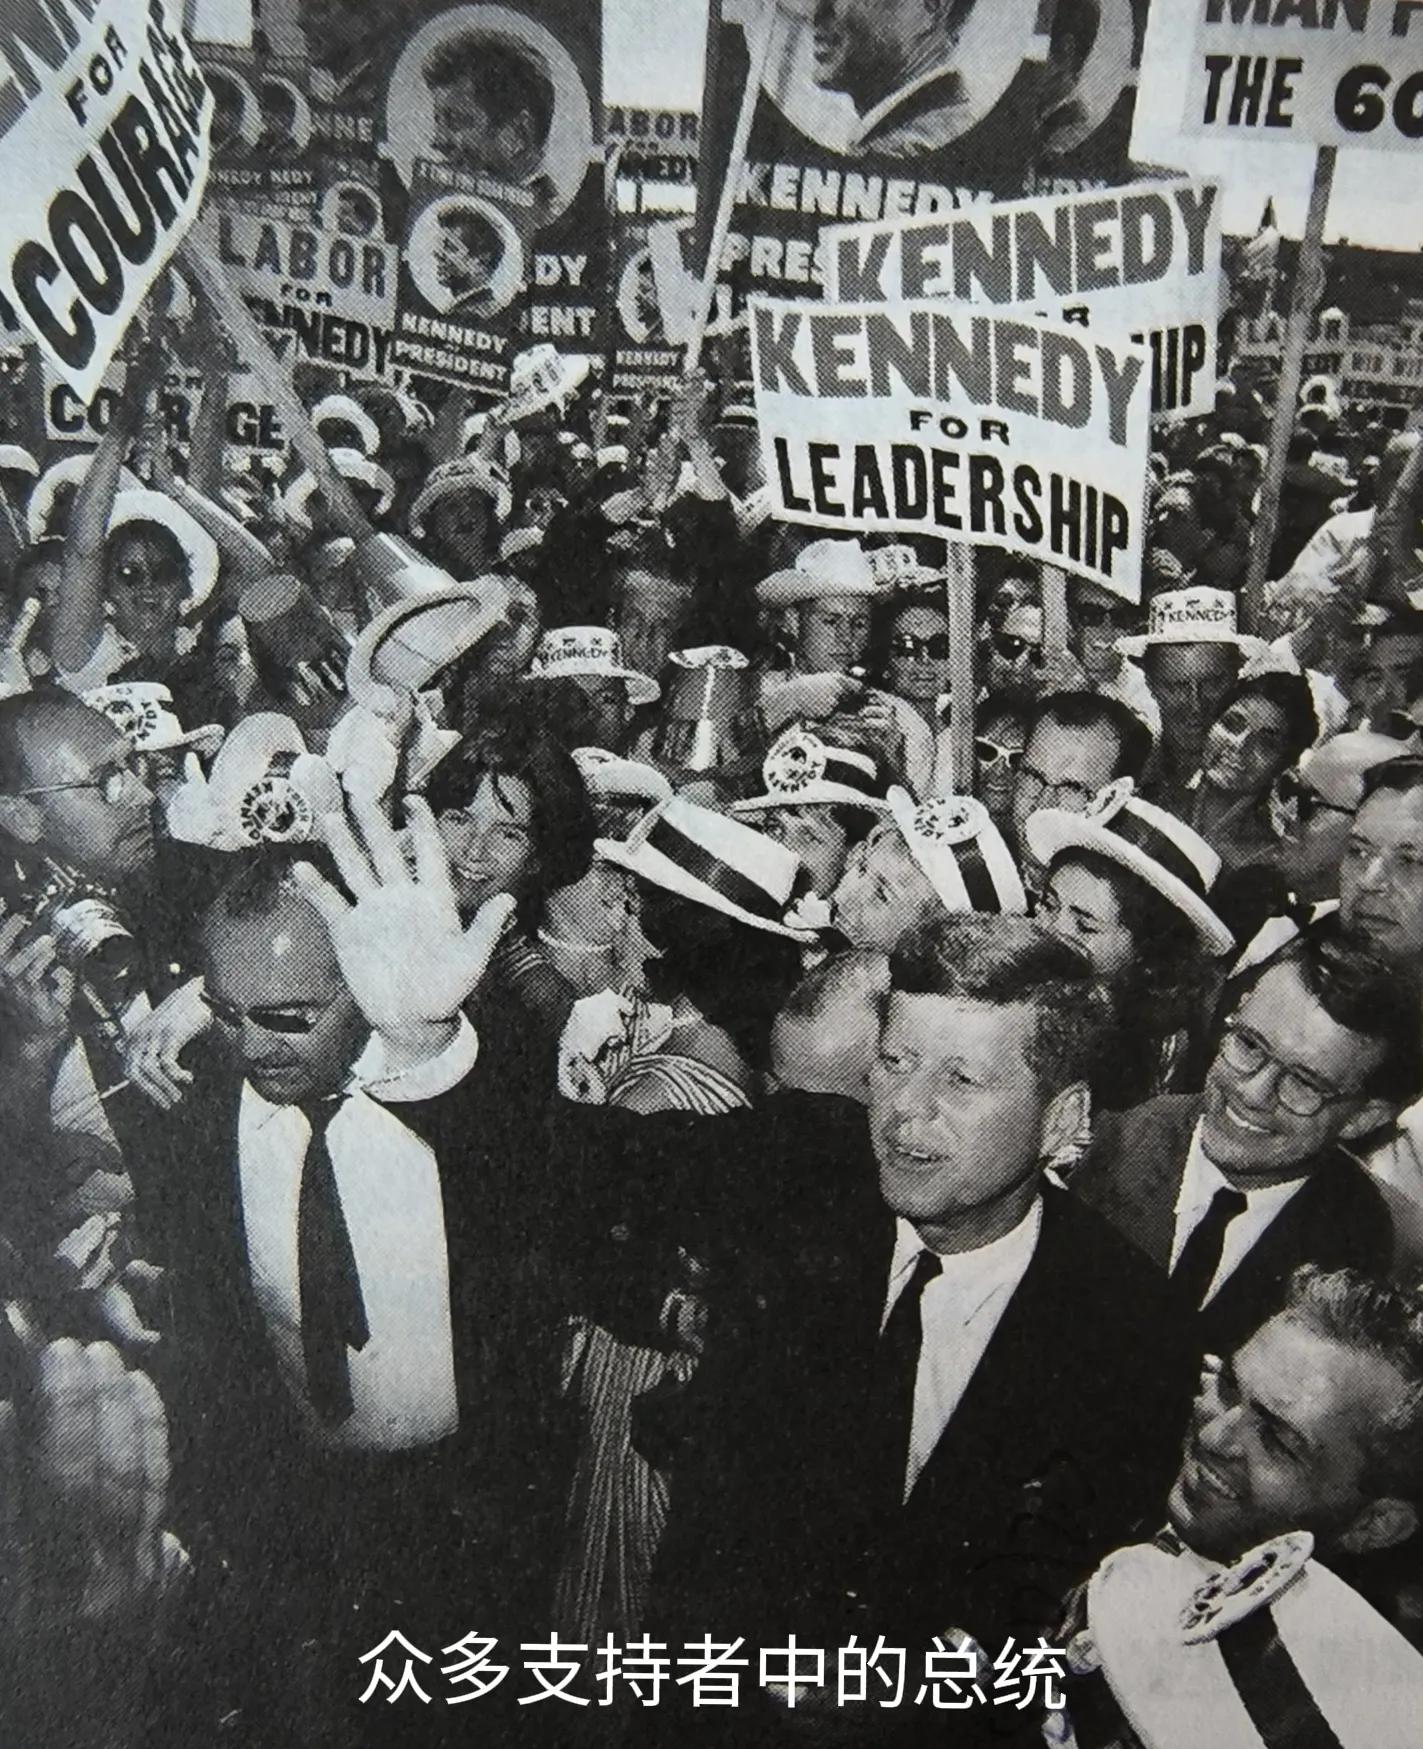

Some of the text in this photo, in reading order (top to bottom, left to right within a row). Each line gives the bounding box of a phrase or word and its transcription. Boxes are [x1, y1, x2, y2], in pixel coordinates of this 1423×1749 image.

[64, 24, 128, 128] FOR
[1204, 56, 1303, 127] THE
[607, 107, 698, 142] ABOR
[12, 0, 206, 371] COURAGE
[218, 214, 385, 298] LABOR
[837, 182, 1218, 303] KENNEDY
[535, 254, 587, 286] DY
[281, 283, 333, 307] FOR
[402, 312, 508, 354] KENNEDY
[531, 305, 596, 337] ENT
[396, 340, 507, 382] PRESIDENT
[752, 309, 1145, 448] KENNEDY
[909, 409, 1010, 446] FOR
[774, 437, 1130, 578] LEADERSHIP
[1168, 609, 1229, 623] KENNEDY
